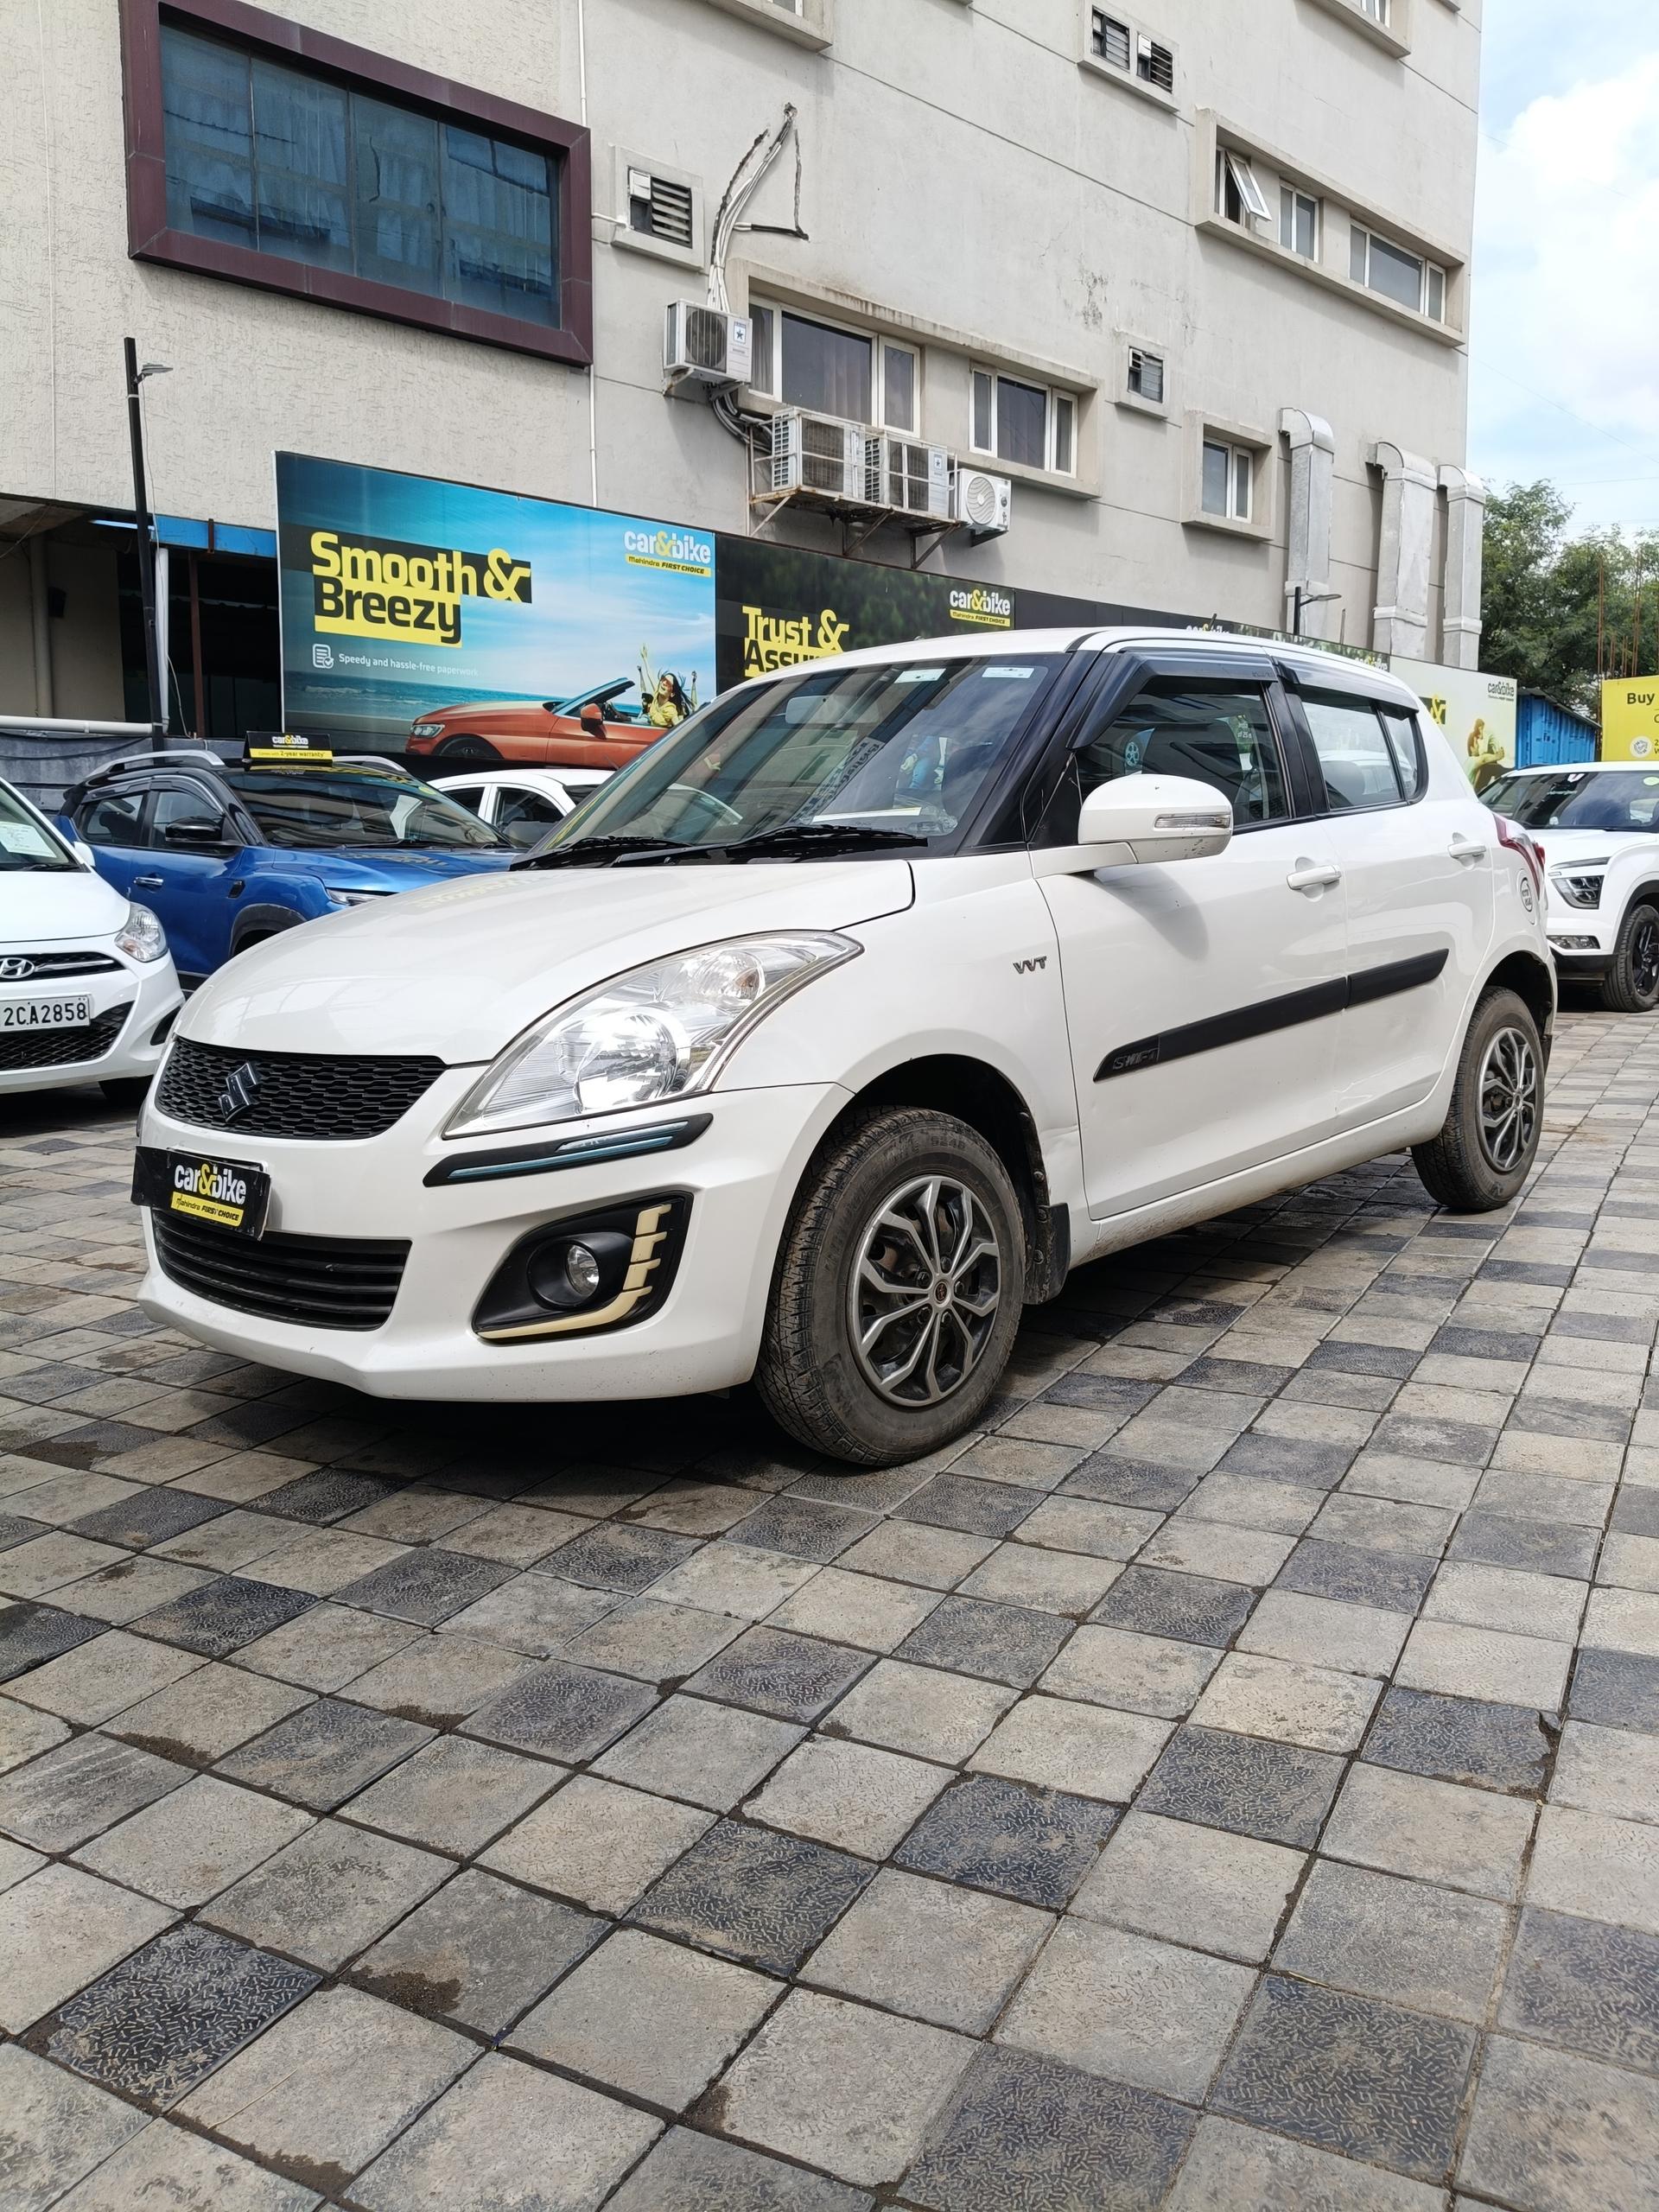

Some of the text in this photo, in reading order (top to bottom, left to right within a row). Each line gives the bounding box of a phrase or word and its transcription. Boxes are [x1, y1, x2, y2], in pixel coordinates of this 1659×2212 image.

[624, 531, 711, 564] car&bike
[311, 531, 531, 602] Smooth &
[629, 556, 705, 574] Mahindra FIRST CHOICE
[315, 575, 461, 645] Breezy
[950, 588, 1011, 616] car&bike
[742, 606, 849, 652] Trust &
[338, 653, 372, 667] Speedy
[372, 658, 389, 667] and
[390, 658, 435, 672] hassle-free
[1626, 692, 1656, 706] Buy
[174, 1163, 247, 1205] car&bike
[218, 1209, 240, 1222] CHOICE
